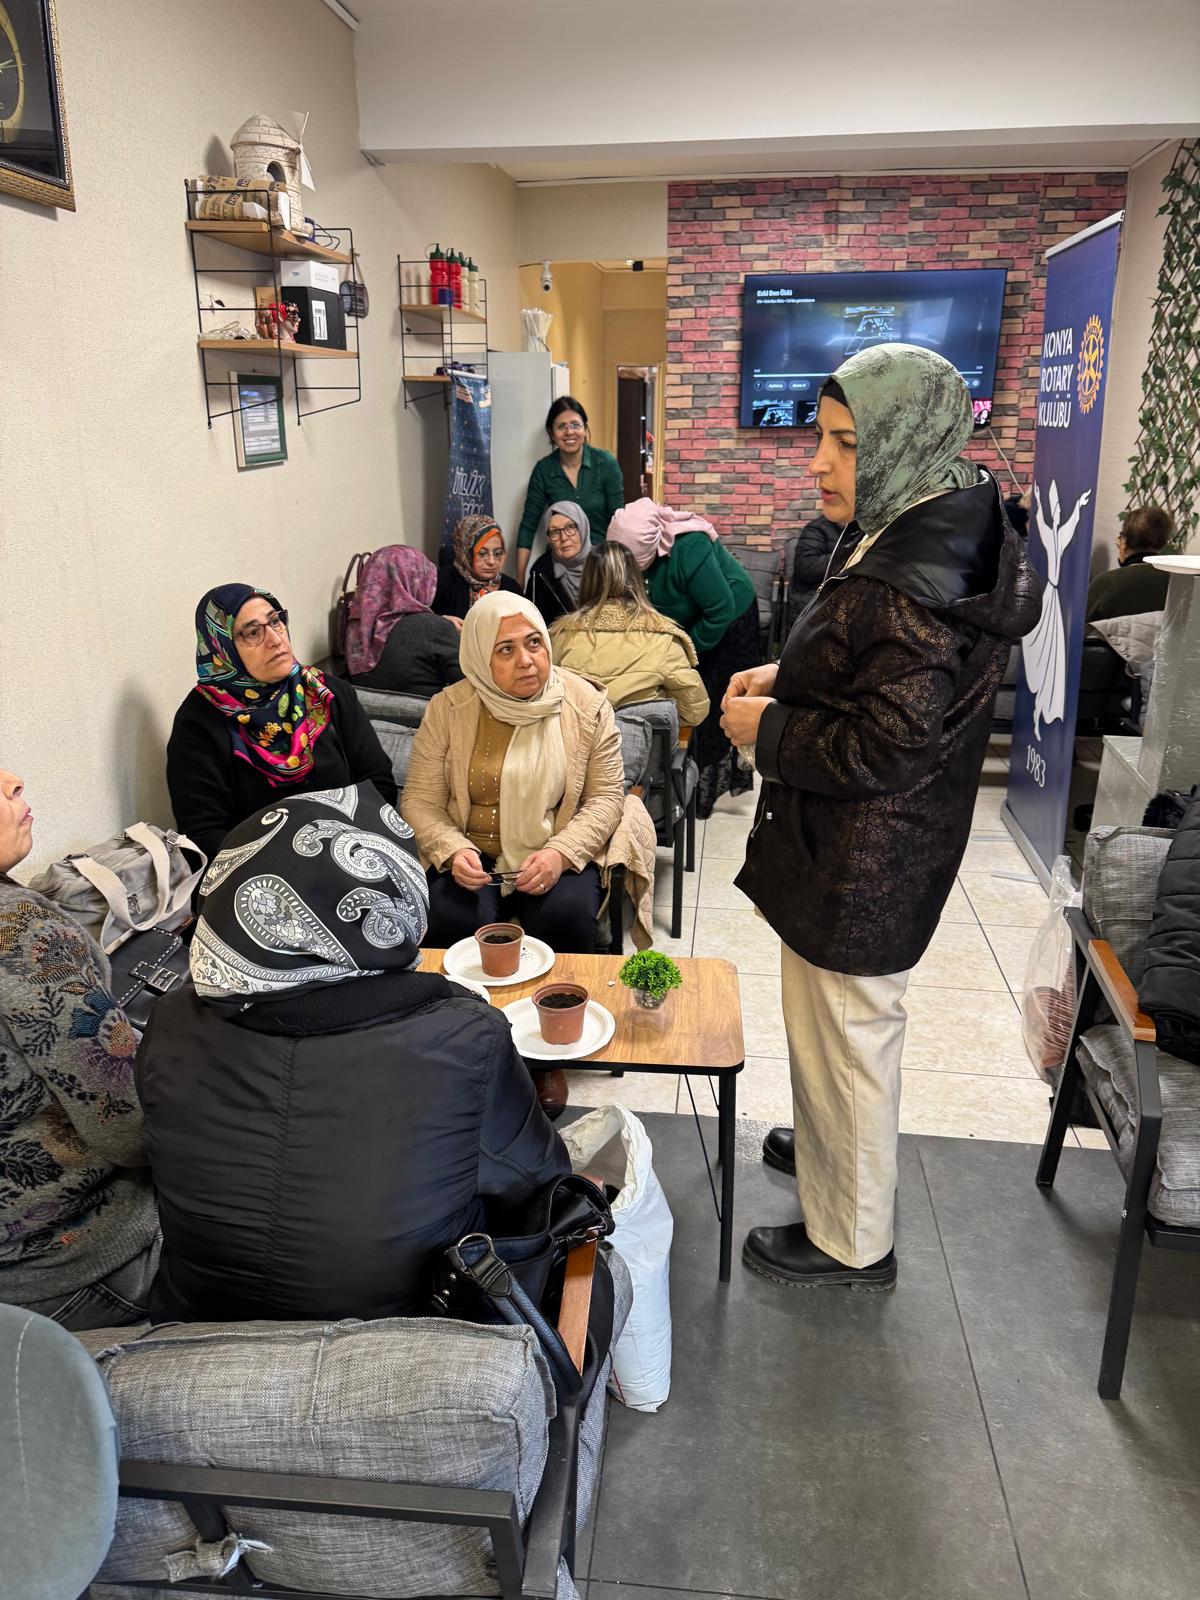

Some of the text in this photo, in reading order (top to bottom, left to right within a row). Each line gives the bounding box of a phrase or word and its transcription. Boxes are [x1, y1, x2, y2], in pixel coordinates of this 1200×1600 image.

[1043, 328, 1073, 359] KONYA
[1040, 364, 1074, 393] ROTARY
[1037, 393, 1072, 428] KULÜBÜ
[1025, 744, 1046, 788] 1983
